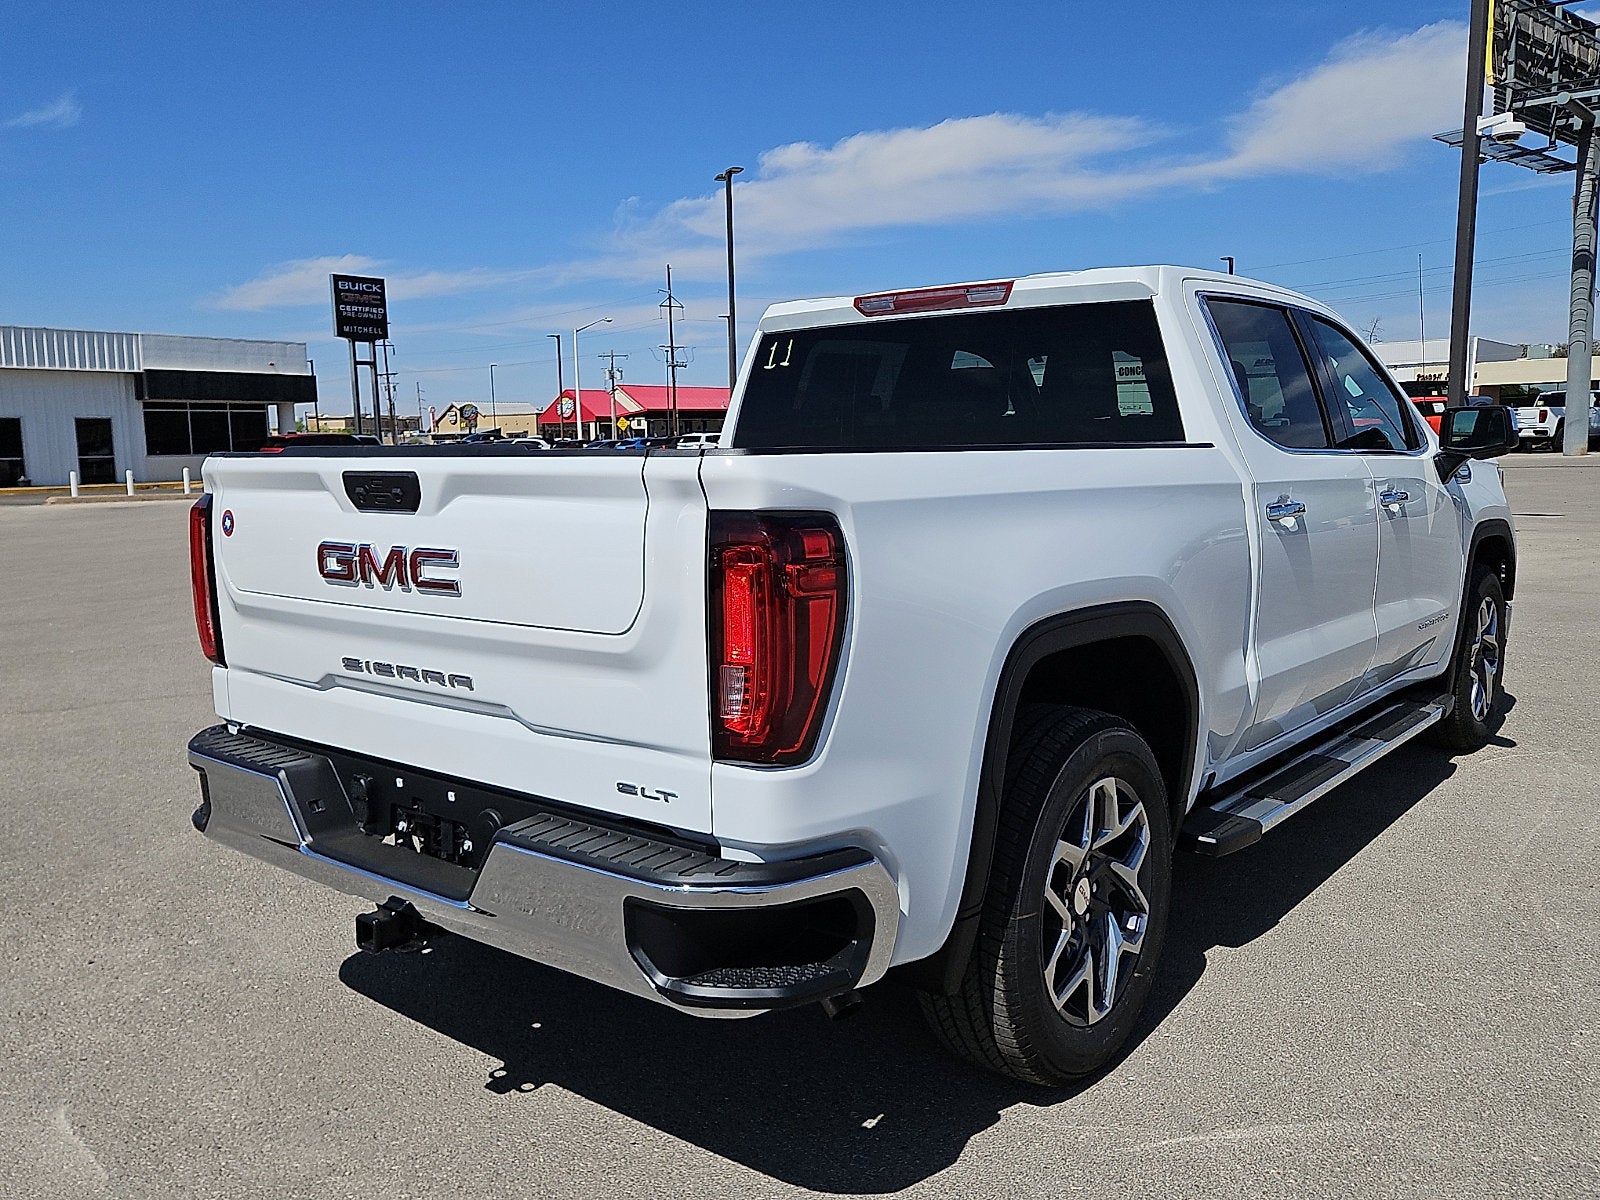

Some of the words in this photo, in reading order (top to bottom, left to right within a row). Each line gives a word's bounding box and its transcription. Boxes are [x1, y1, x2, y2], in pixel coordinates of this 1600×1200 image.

[338, 281, 382, 293] BUICK
[339, 304, 385, 314] CERTIFIED
[342, 311, 383, 320] PRE-OWNED
[343, 325, 383, 335] MITCHELL
[317, 540, 462, 598] GMC
[341, 656, 475, 692] SIERRA
[616, 782, 679, 804] SLT
